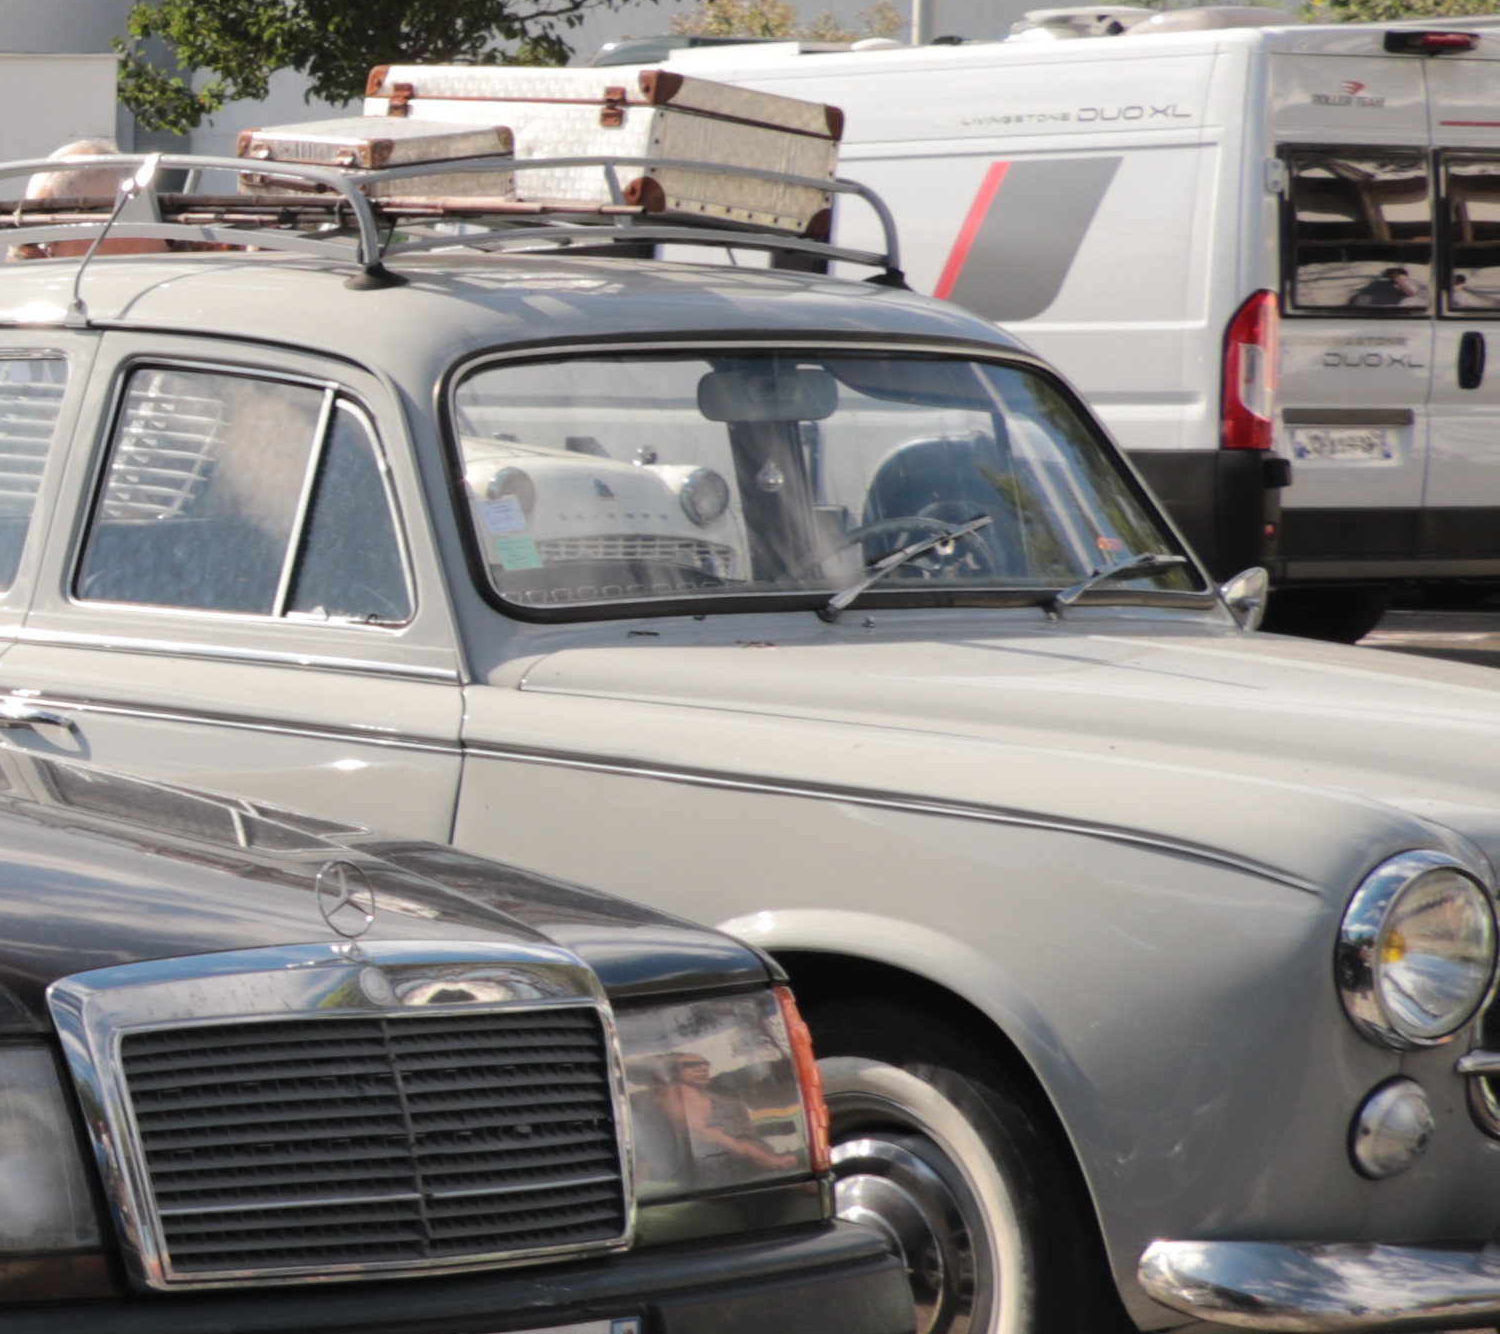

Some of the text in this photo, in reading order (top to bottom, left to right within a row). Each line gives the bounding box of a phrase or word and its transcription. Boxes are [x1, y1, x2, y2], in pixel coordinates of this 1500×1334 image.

[1076, 105, 1144, 123] DUO
[1150, 104, 1192, 119] XL
[1323, 352, 1425, 368] DUO XL
